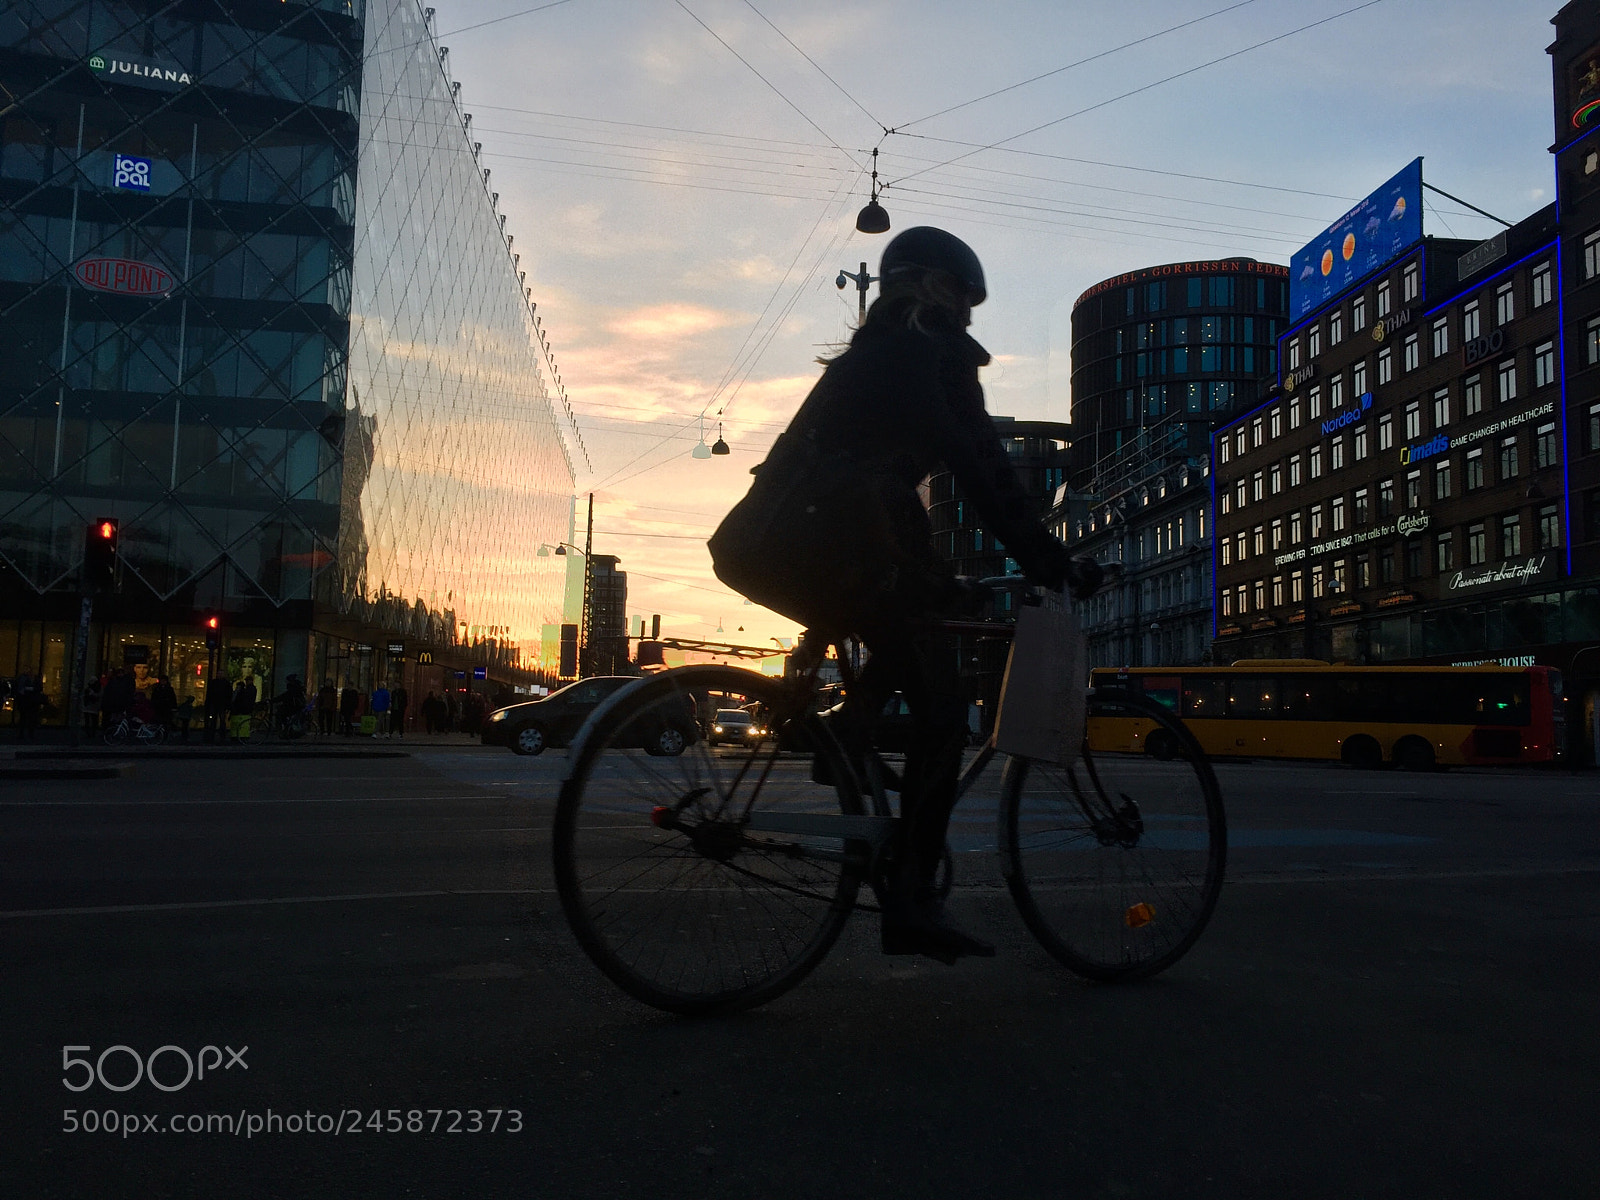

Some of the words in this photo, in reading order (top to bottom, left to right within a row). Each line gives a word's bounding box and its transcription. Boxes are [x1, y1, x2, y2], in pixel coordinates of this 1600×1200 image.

[110, 60, 191, 85] JULIANA
[115, 154, 149, 174] ico
[1152, 262, 1240, 277] GORRISSEN
[1385, 308, 1410, 334] THAI
[1466, 328, 1503, 363] BDO
[1294, 364, 1314, 386] THAI
[1321, 408, 1361, 435] Nordea
[1410, 433, 1449, 463] imatis
[1450, 434, 1468, 449] GAME
[1468, 423, 1500, 442] CHANGER
[1500, 420, 1508, 431] IN
[1508, 402, 1554, 427] HEALTHCARE
[1325, 539, 1340, 552] SINCE
[1353, 533, 1367, 543] That
[1368, 527, 1380, 540] calls
[1381, 525, 1390, 536] for
[1397, 510, 1430, 537] Carlsberg
[1449, 570, 1497, 590] Passionate
[1494, 561, 1523, 581] about
